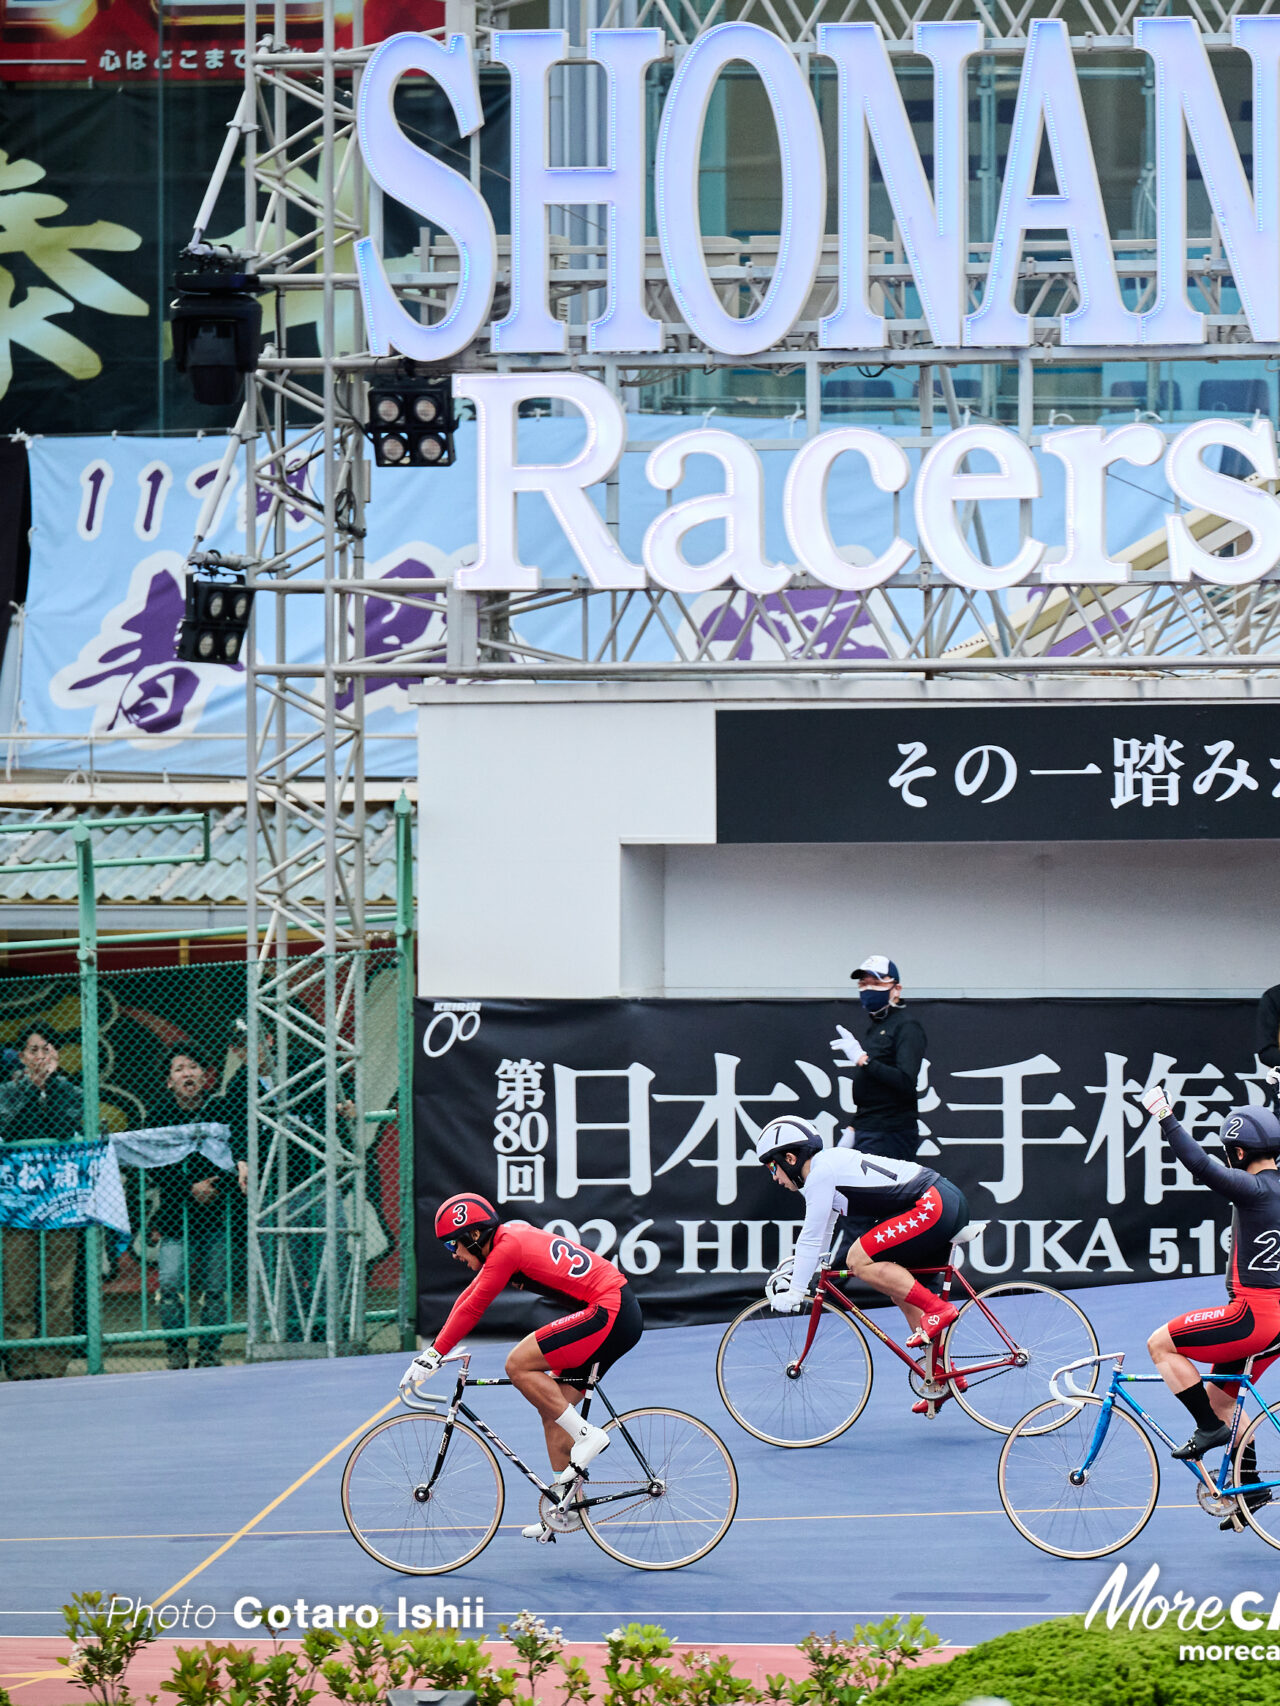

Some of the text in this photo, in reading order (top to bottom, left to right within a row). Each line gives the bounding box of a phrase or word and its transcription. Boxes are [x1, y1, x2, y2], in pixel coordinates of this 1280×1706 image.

[773, 1124, 782, 1145] 1
[1224, 1116, 1243, 1139] 2
[860, 1159, 898, 1182] 1
[452, 1203, 468, 1227] 3
[549, 1238, 593, 1278] 3
[551, 1310, 585, 1328] KEIRIN
[1184, 1308, 1226, 1325] KEIRIN
